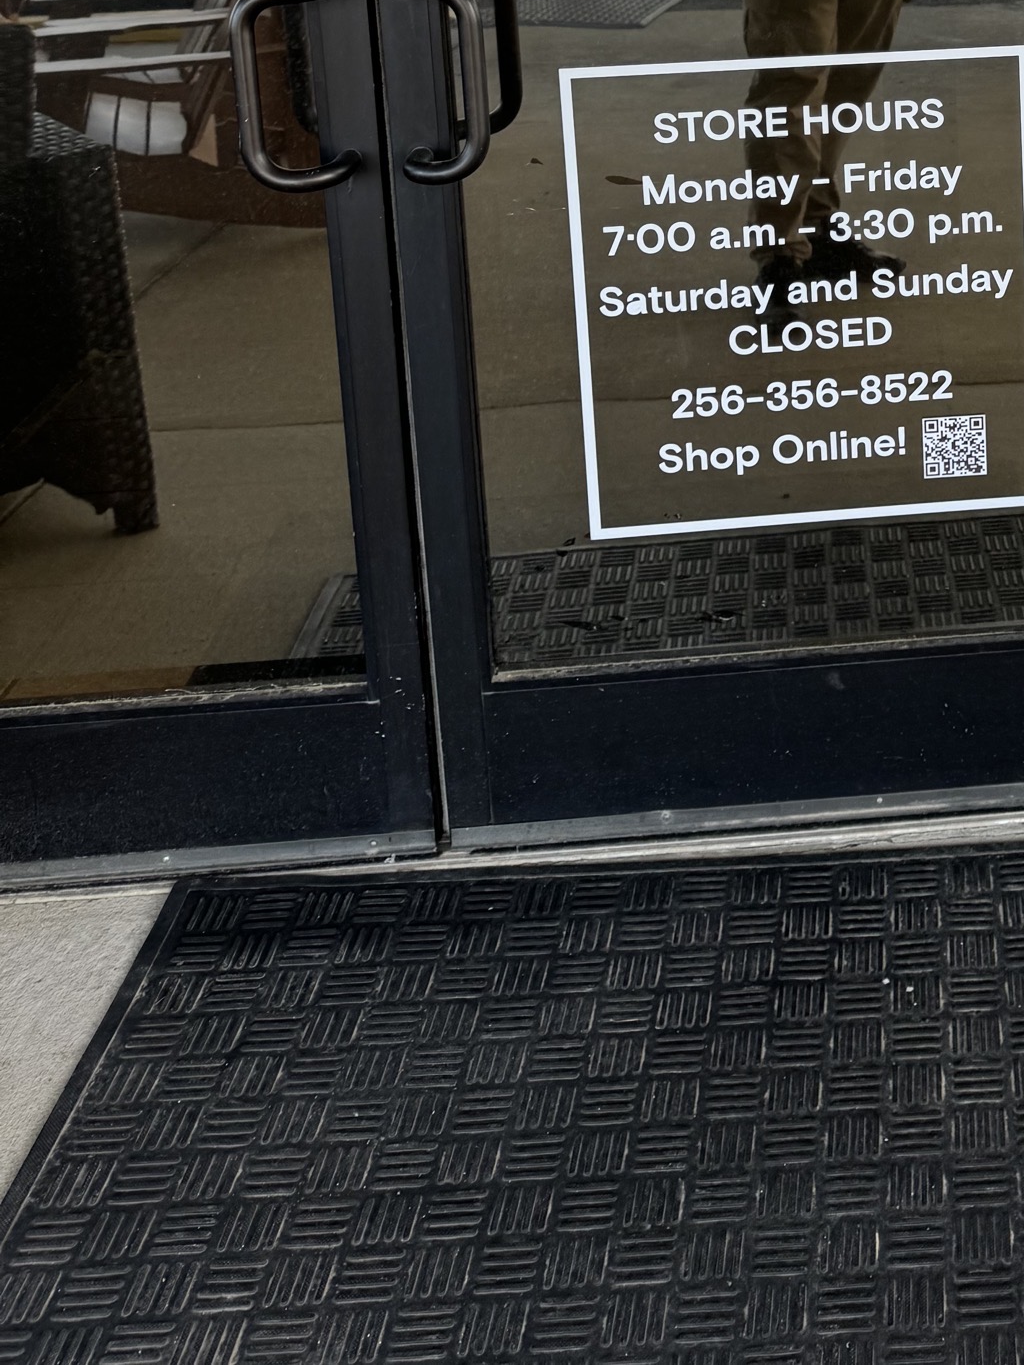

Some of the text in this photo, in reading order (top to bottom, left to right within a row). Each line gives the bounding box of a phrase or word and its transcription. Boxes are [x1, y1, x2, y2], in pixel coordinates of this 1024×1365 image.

[654, 98, 944, 143] STORE HOURS
[642, 160, 962, 205] Monday Friday
[603, 210, 1002, 256] 7:00 a.m. 3:30 p.m.
[600, 266, 1013, 317] Saturday and Sunday
[729, 317, 892, 355] CLOSED
[672, 370, 953, 419] 256-356-8522
[659, 426, 905, 475] Shop Online!
